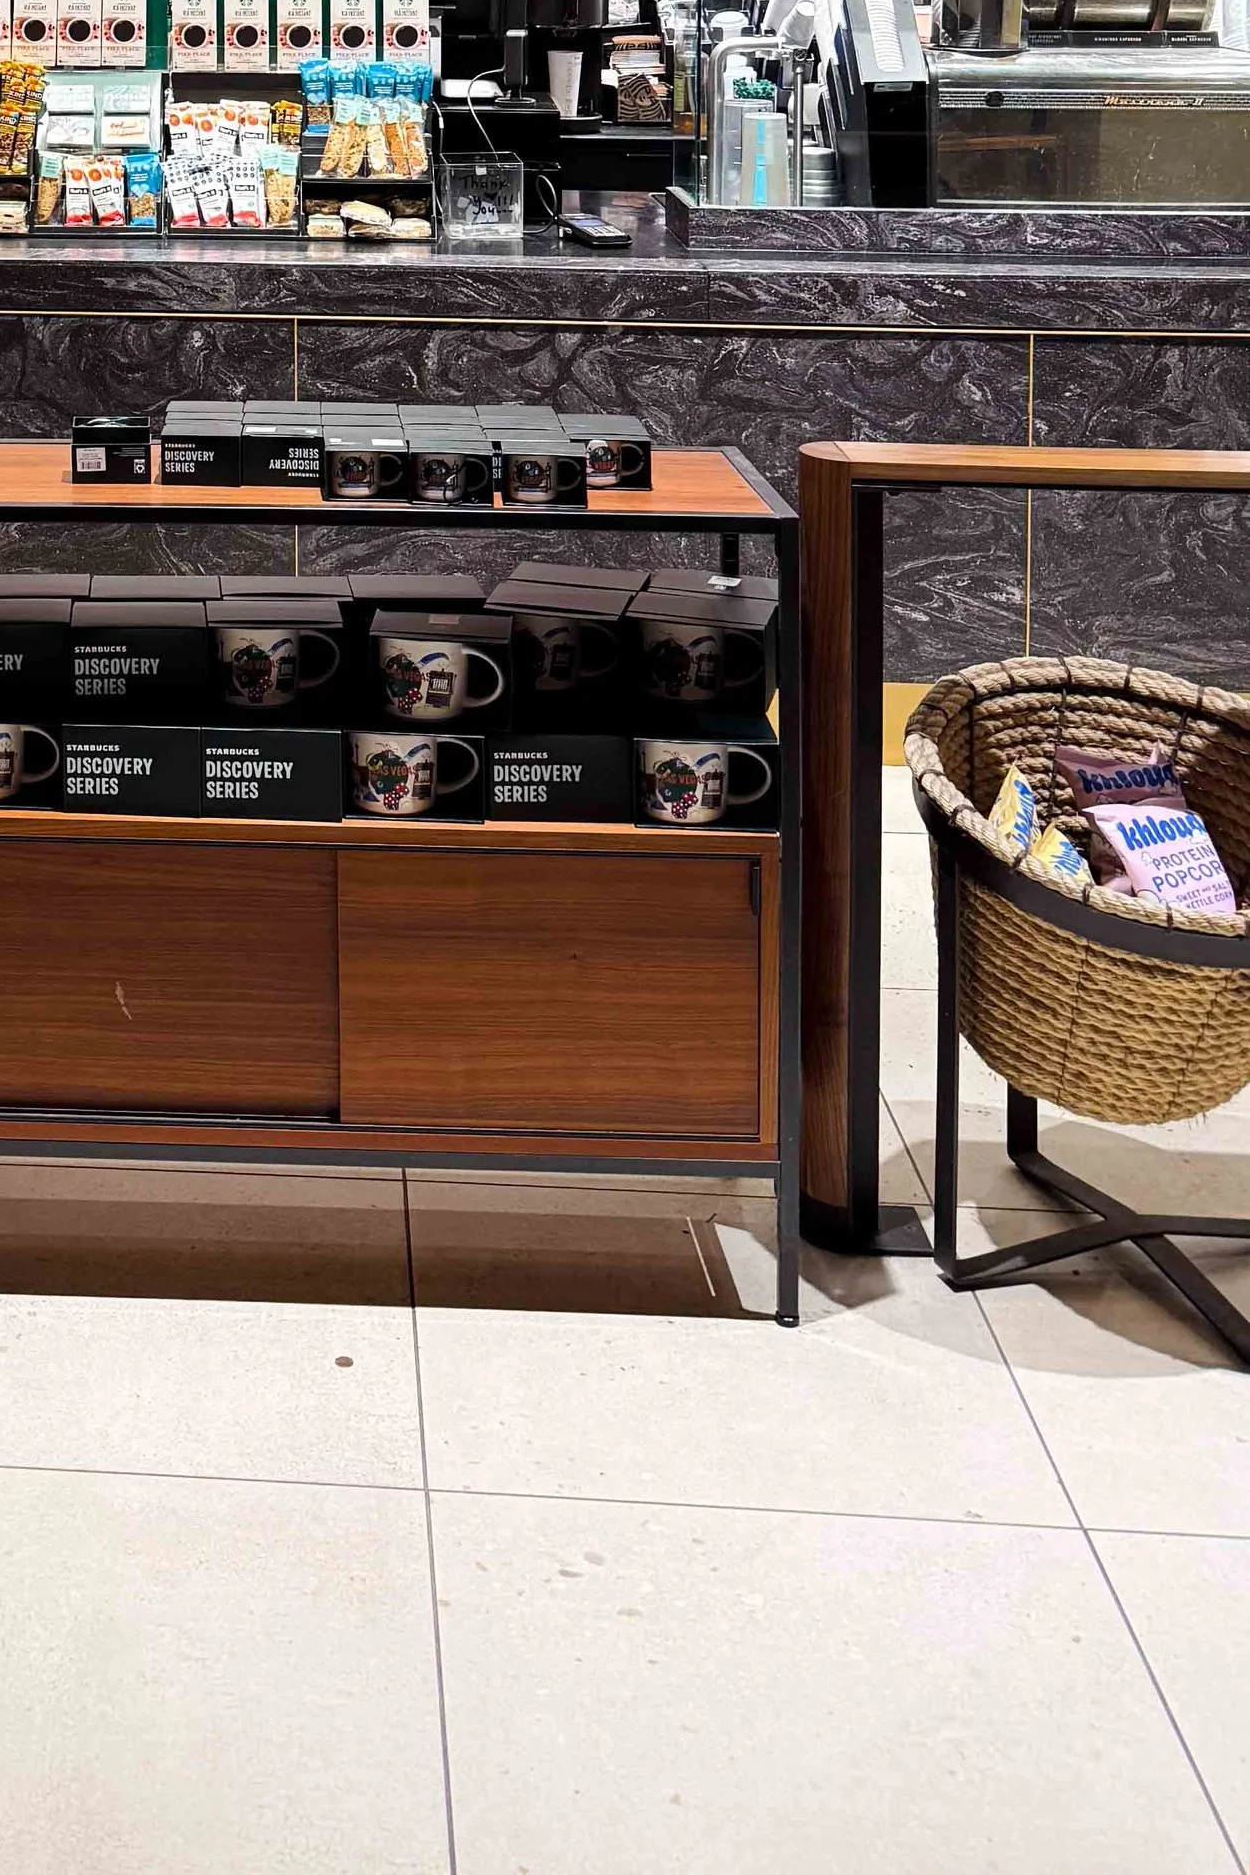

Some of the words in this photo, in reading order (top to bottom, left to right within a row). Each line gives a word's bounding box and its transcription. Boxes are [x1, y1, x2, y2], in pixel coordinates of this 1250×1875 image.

[165, 451, 215, 462] DISCOVERY
[288, 448, 319, 459] SERIES
[165, 463, 195, 473] SERIES
[269, 459, 319, 470] DISCOVERY
[74, 645, 127, 654] STARBUCKS
[74, 658, 161, 676] DISCOVERY
[75, 678, 127, 696] SERIES
[66, 744, 120, 752] STARBUCKS
[206, 747, 260, 756] STARBUCKS
[493, 751, 549, 760] STARBUCKS
[66, 757, 153, 776] DISCOVERY
[206, 760, 294, 779] DISCOVERY
[494, 764, 583, 784] DISCOVERY
[66, 777, 120, 796] SERIES
[206, 781, 260, 800] SERIES
[494, 785, 547, 803] SERIES
[1152, 845, 1215, 871] PROTEIN
[1152, 860, 1224, 893] POPCOR
[1176, 890, 1201, 902] SWEET
